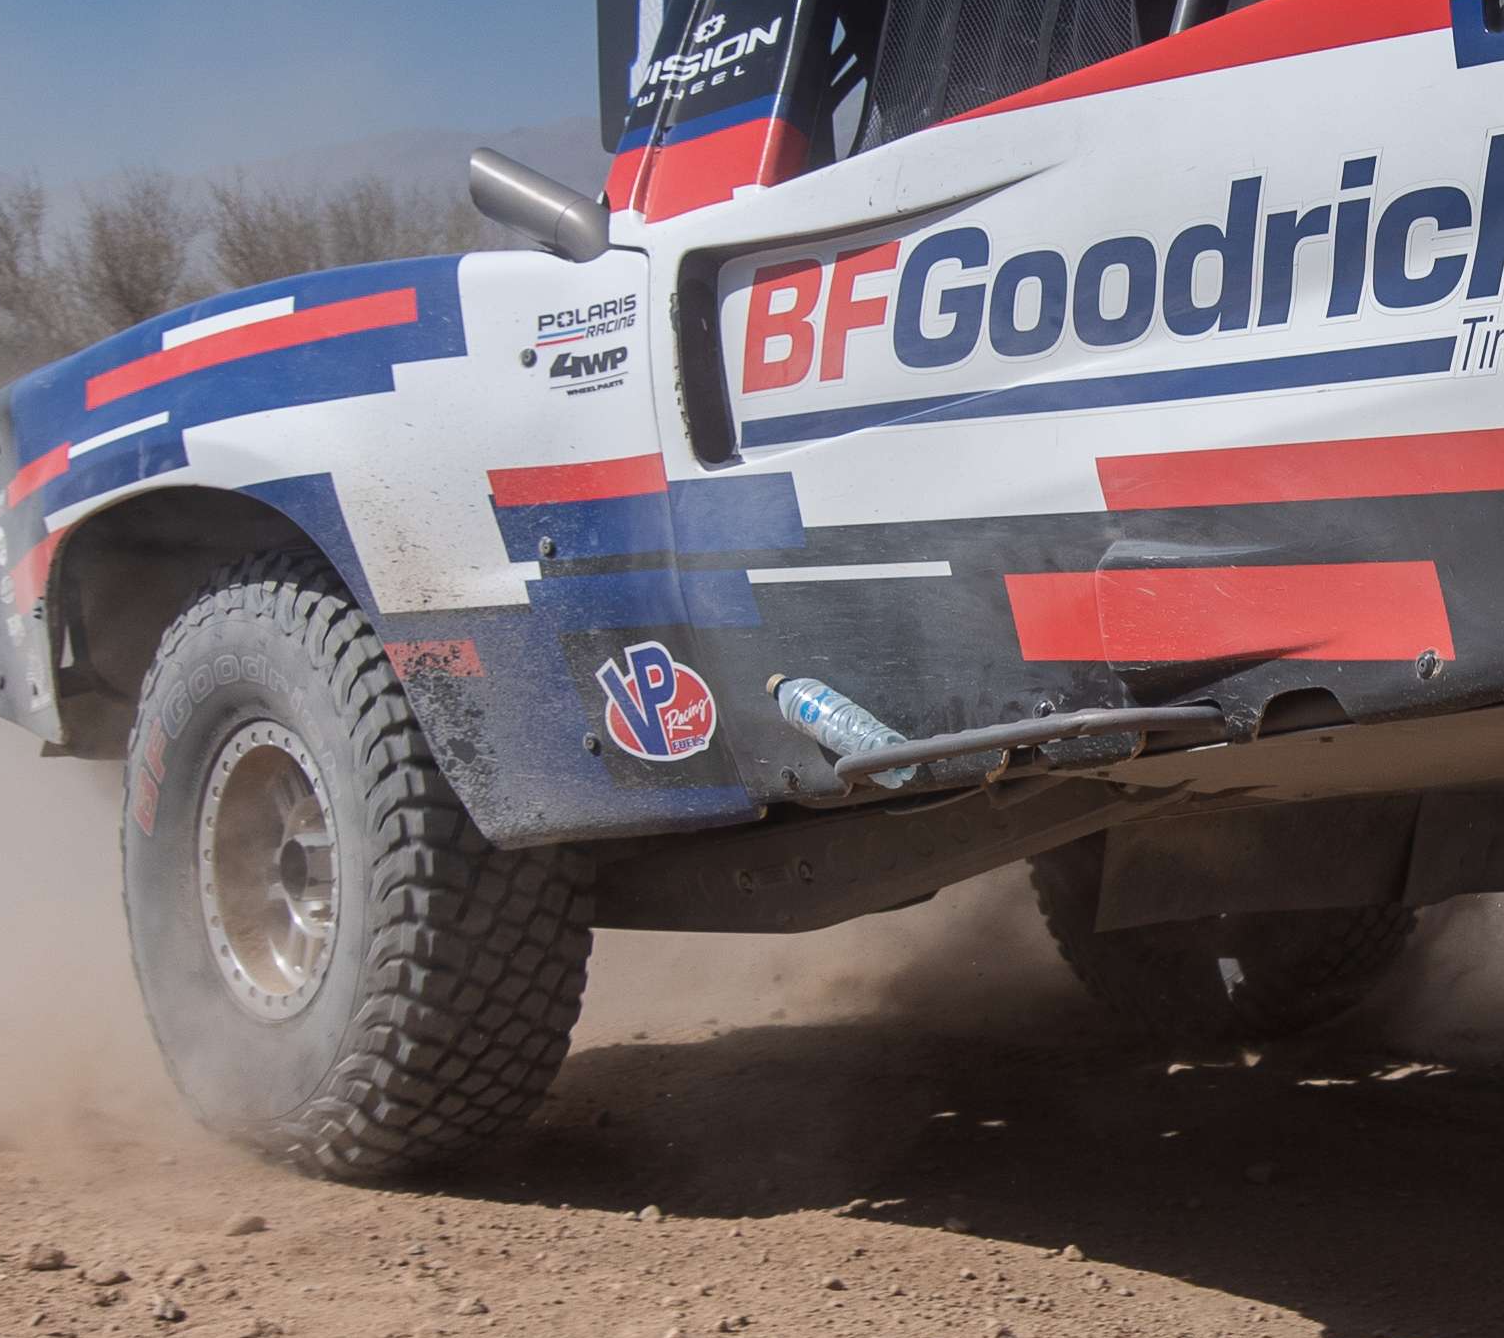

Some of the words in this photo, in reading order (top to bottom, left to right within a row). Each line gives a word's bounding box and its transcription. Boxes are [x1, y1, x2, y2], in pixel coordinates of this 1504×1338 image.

[636, 65, 746, 108] WHEEL
[537, 294, 636, 332] POLARIS
[585, 313, 636, 339] RACING
[549, 346, 628, 378] 4WP
[598, 644, 677, 758] VP
[664, 694, 713, 736] Racing
[671, 735, 706, 753] FUELS
